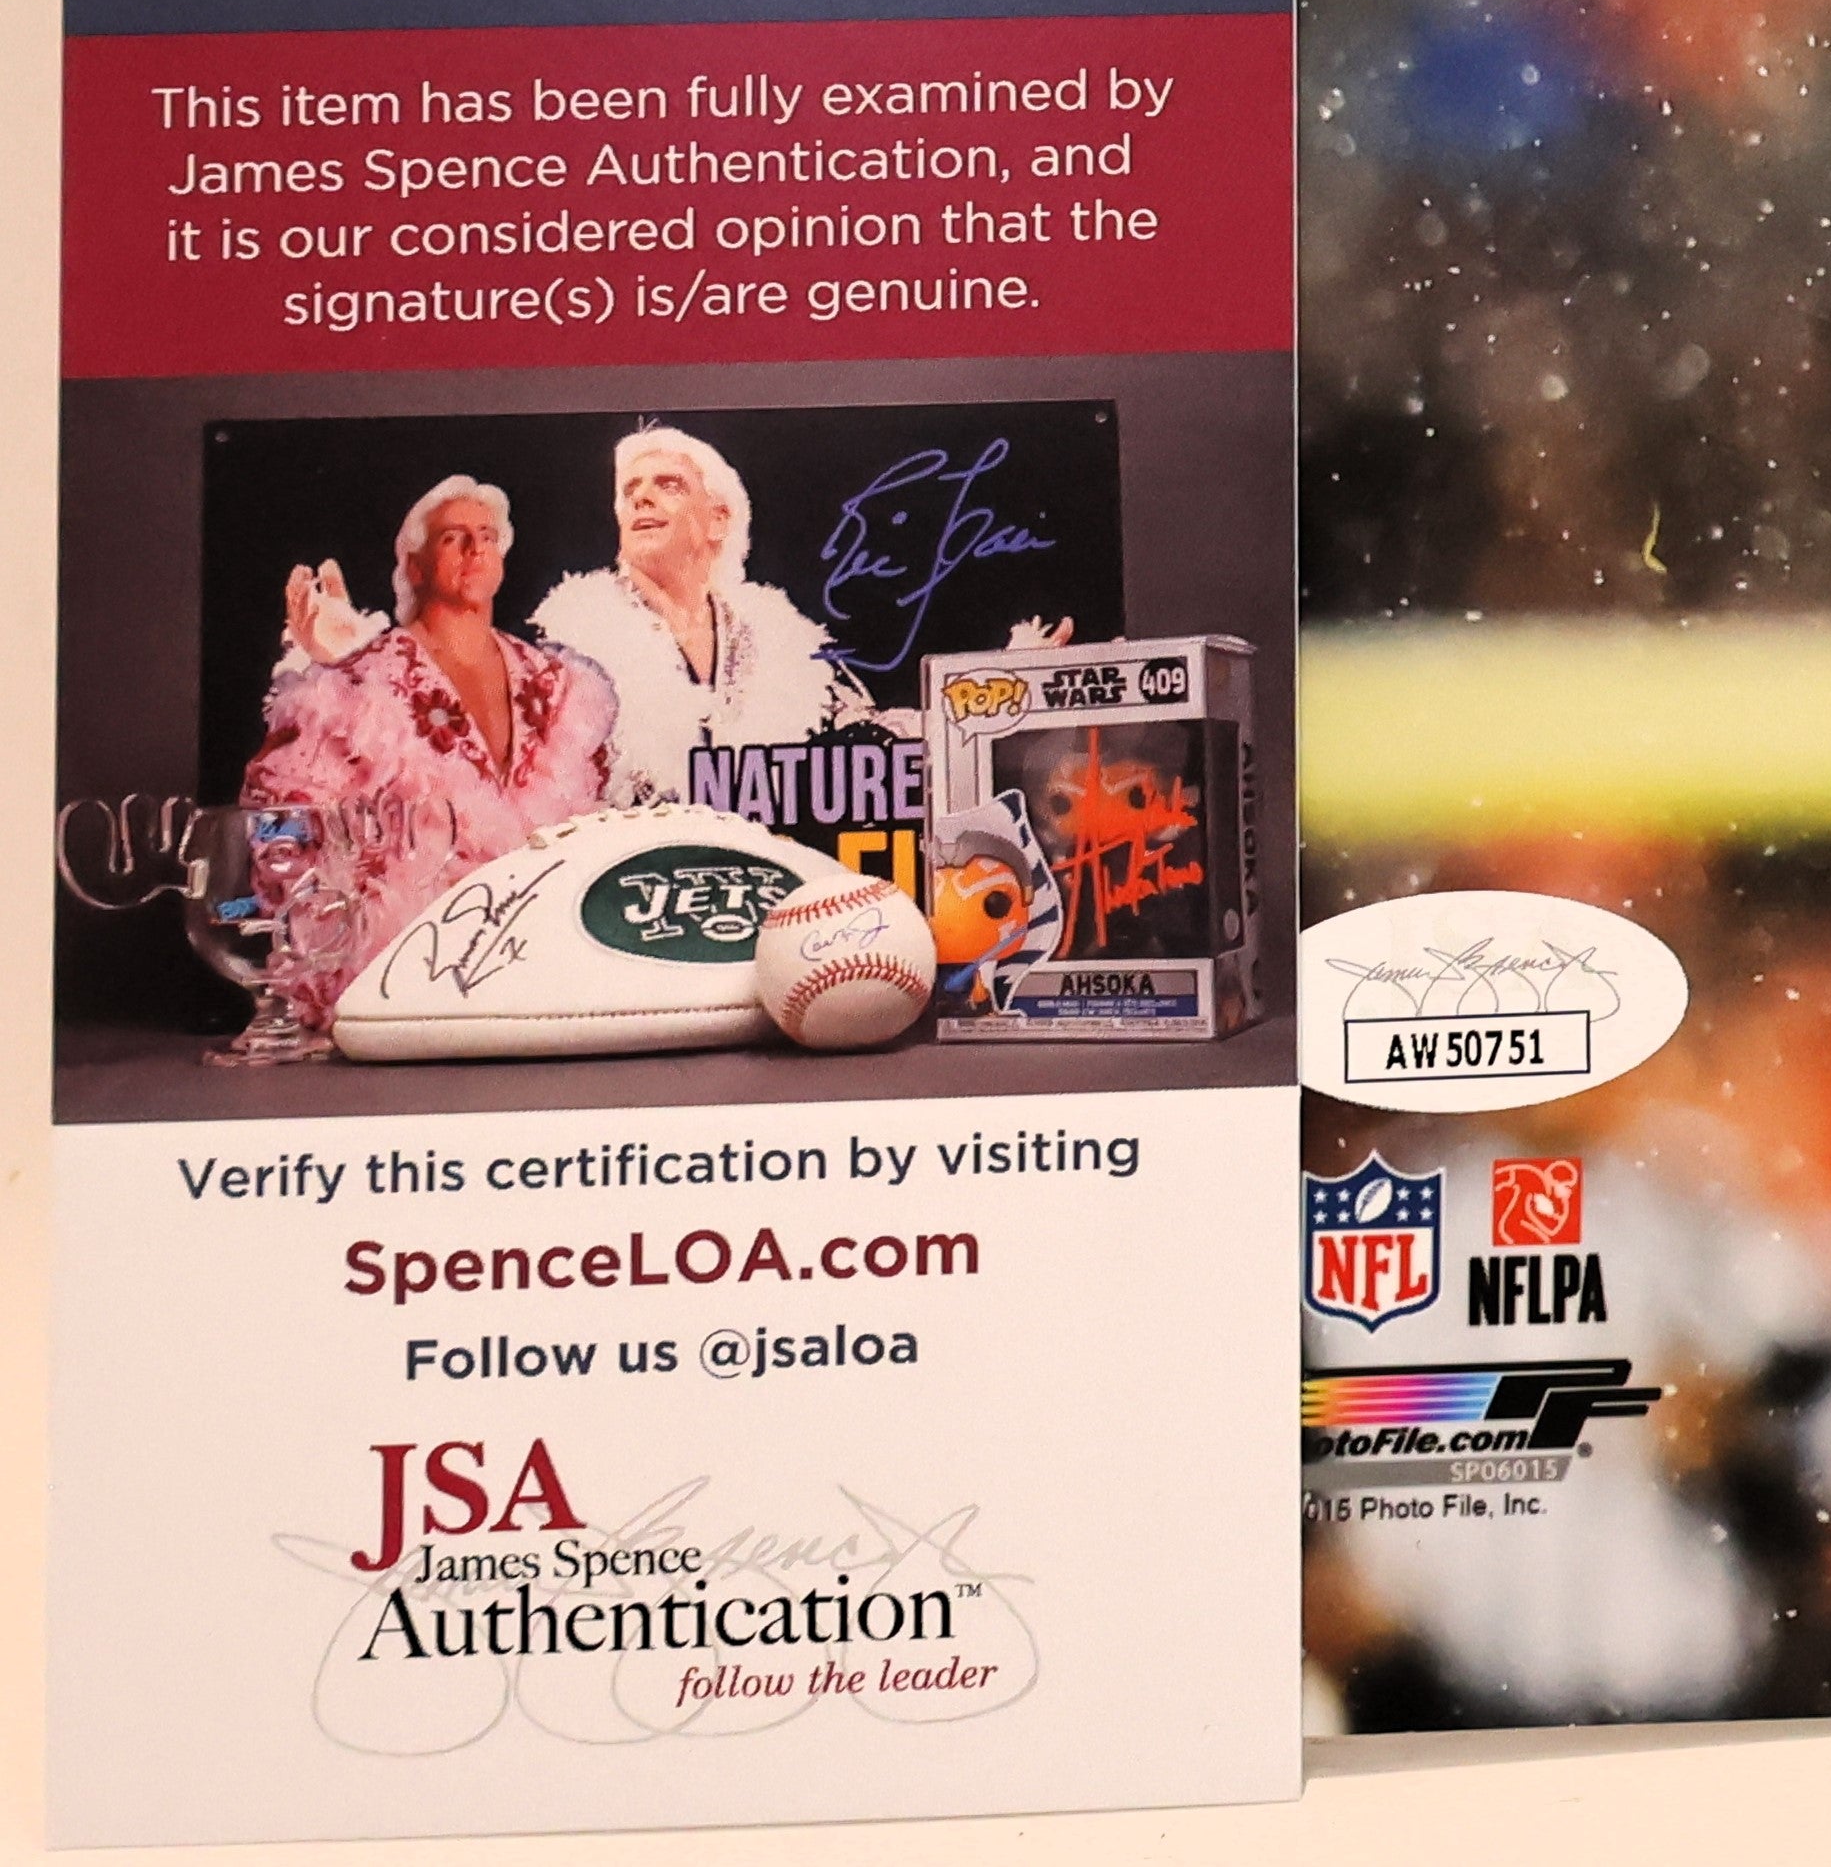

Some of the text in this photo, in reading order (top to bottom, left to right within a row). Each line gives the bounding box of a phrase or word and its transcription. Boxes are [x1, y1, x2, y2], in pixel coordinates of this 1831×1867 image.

[151, 67, 1174, 129] This item has been fully examined by
[168, 132, 1130, 199] James Spence Authentication, and
[168, 200, 1158, 261] it is our considered opinion that the
[284, 268, 1039, 332] signature(s) is/are genuine.
[1041, 666, 1127, 688] STAR
[1042, 685, 1127, 708] WARS
[1141, 666, 1187, 697] 409
[692, 742, 927, 826] NATURE
[623, 881, 788, 925] JETS
[1059, 972, 1156, 996] AHSOKA
[177, 1129, 1139, 1204] Verify this certification by visiting
[344, 1227, 979, 1306] SpenceLOA.com
[1317, 1233, 1429, 1311] NFL
[1467, 1252, 1608, 1327] NFLPA
[406, 1324, 918, 1381] Follow us @jsaloa
[350, 1437, 587, 1574] JSA
[1359, 1494, 1434, 1521] Photo
[1442, 1493, 1495, 1519] File,
[1503, 1492, 1548, 1516] Inc.
[414, 1539, 707, 1589] James Spence
[675, 1656, 999, 1708] follow the leader
